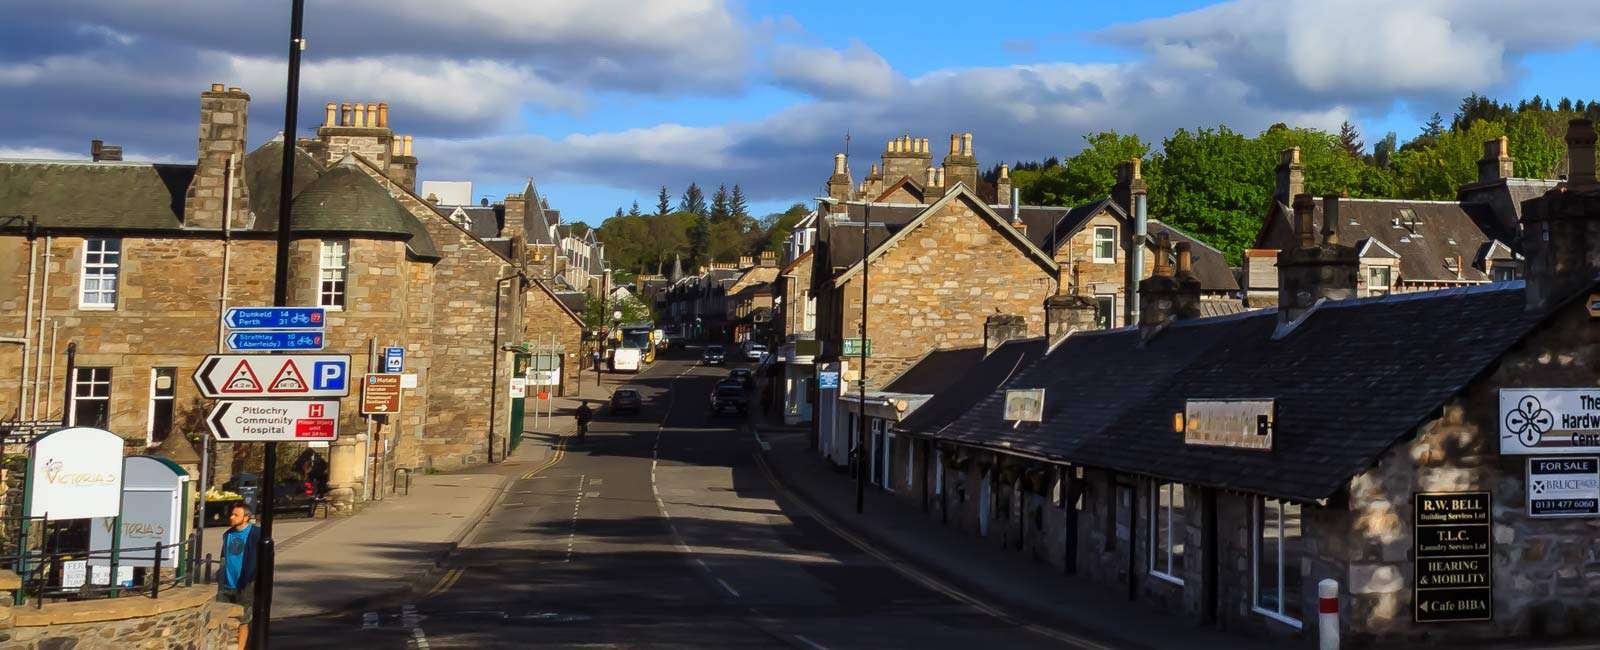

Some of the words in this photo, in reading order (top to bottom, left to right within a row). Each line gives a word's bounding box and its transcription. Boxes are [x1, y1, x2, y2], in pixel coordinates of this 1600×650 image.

[239, 310, 272, 318] Dunkeld
[320, 364, 342, 388] P
[1580, 395, 1600, 410] The
[242, 406, 289, 418] Pitlochry
[310, 405, 322, 417] H
[235, 416, 293, 426] Community
[242, 426, 285, 435] Hospital
[1540, 462, 1562, 471] FOR
[1563, 461, 1589, 470] SALE
[1424, 500, 1449, 511] R.W.
[1452, 499, 1483, 510] BELL
[1536, 500, 1557, 509] 0131
[1558, 500, 1573, 509] 477
[1574, 499, 1595, 508] 6060
[1421, 513, 1447, 521] Building
[1447, 512, 1473, 520] Services
[1474, 511, 1486, 519] Ltd
[1437, 530, 1470, 541] T.L.C.
[1420, 544, 1447, 552] Laundry
[1448, 543, 1473, 551] Services
[1474, 542, 1486, 550] Ltd
[1428, 560, 1478, 571] HEARING
[1420, 575, 1428, 584] &
[1432, 574, 1486, 584] MOBILITY
[1431, 600, 1455, 611] Cafe
[1458, 599, 1486, 610] BIBA
